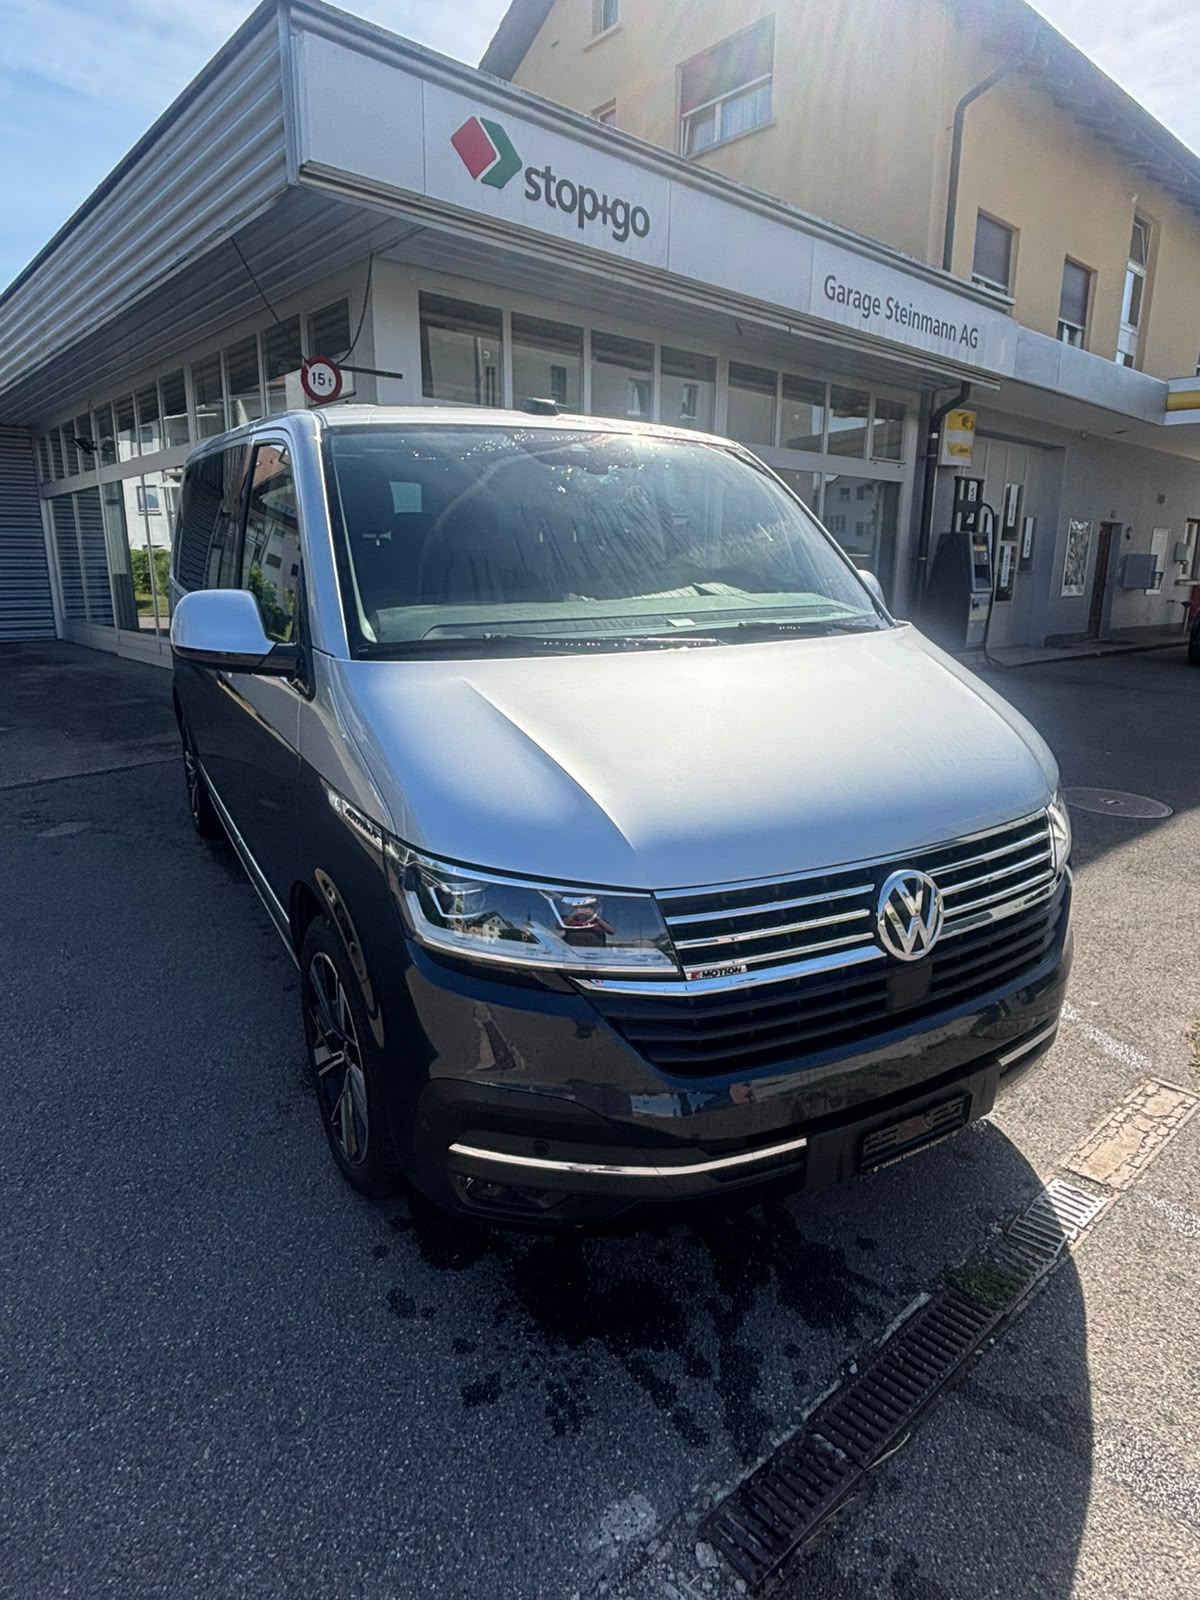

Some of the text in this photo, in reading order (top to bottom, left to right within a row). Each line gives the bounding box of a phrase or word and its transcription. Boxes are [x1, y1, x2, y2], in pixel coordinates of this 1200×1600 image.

[525, 166, 650, 242] stop+go
[824, 274, 979, 349] Garage Steinmann AG
[877, 868, 944, 961] VW
